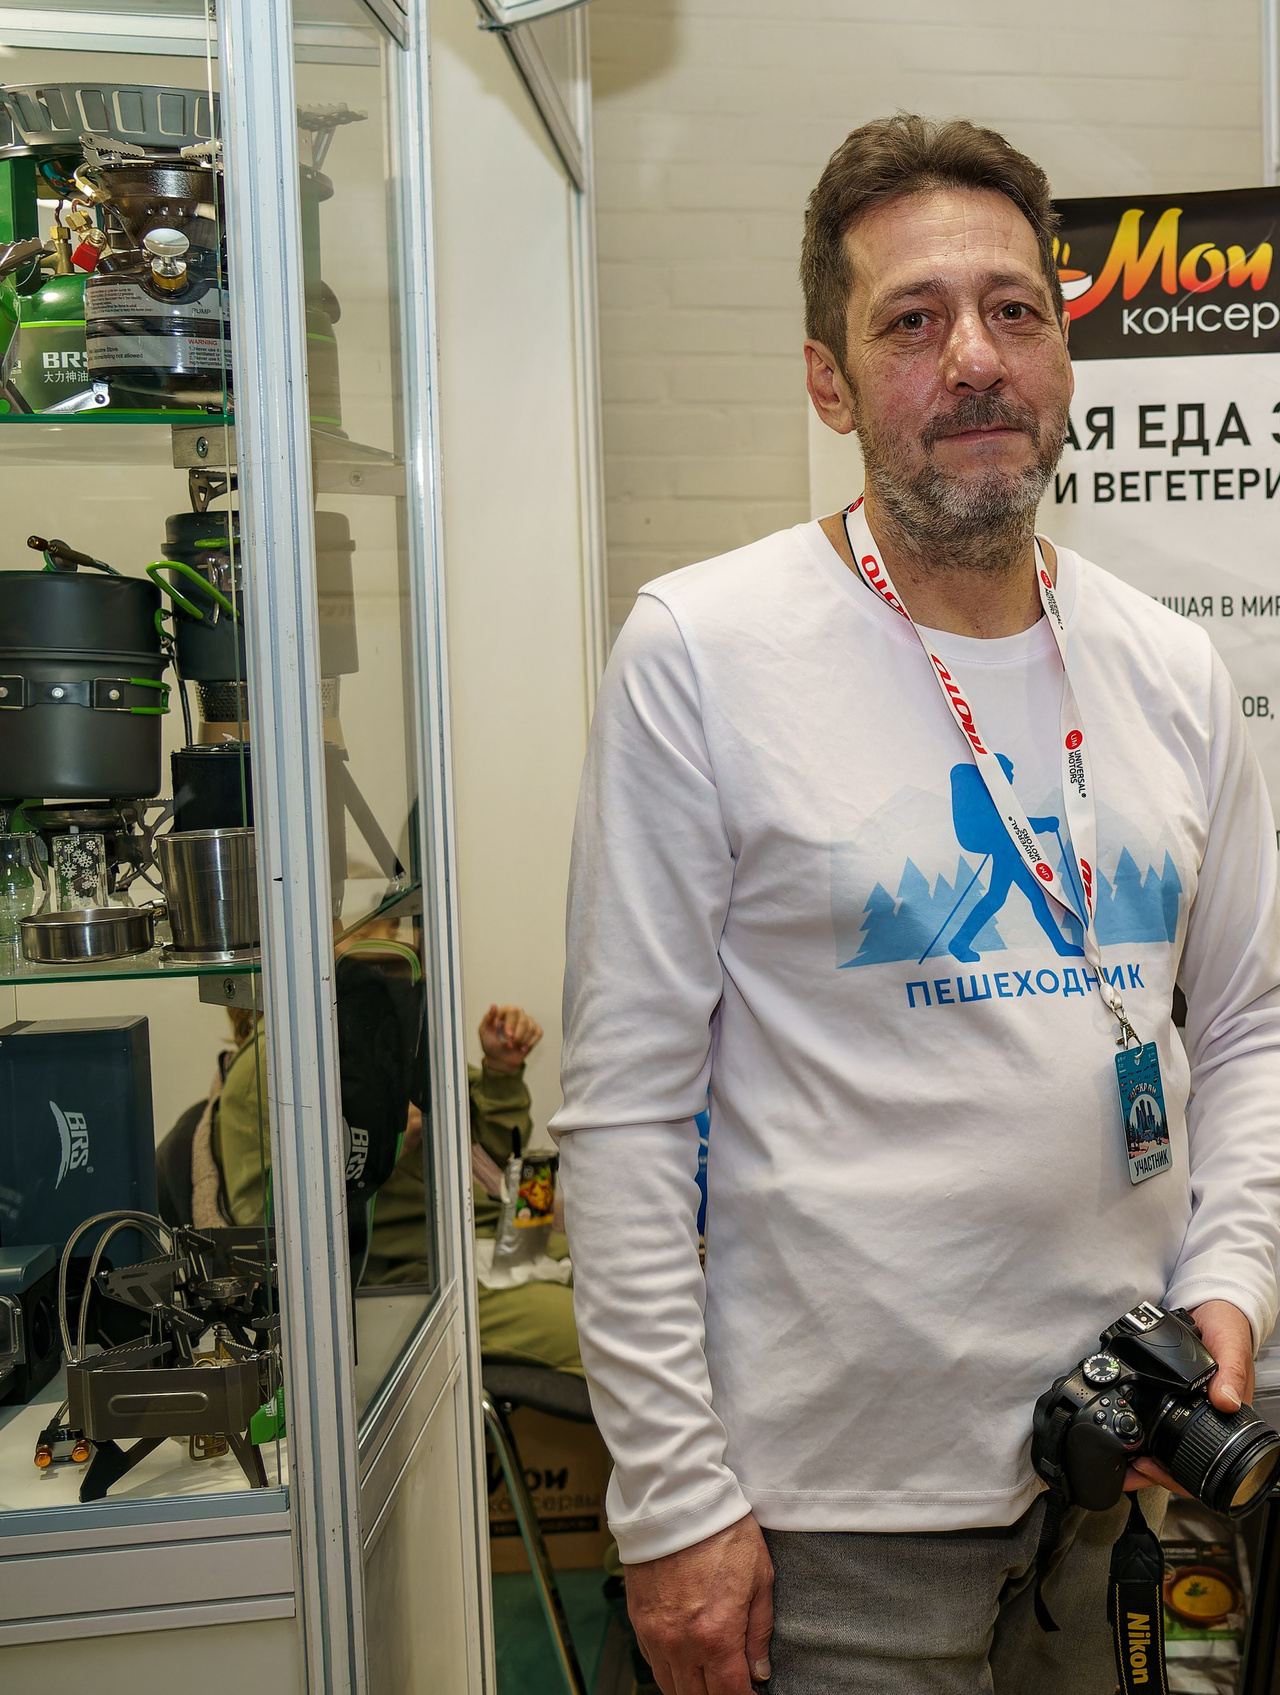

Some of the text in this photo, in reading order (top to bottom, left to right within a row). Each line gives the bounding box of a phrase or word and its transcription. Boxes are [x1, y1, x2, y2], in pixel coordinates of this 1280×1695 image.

[1066, 208, 1273, 320] Мои
[1139, 402, 1252, 456] ЕДА
[1055, 472, 1077, 504] И
[1221, 596, 1234, 617] В
[1067, 751, 1078, 784] MOTORS
[1022, 828, 1042, 861] MOTORS
[905, 963, 1145, 1009] ПЕШЕХОДНИК
[63, 1111, 89, 1170] BRS
[345, 1127, 369, 1180] BRS
[1133, 1149, 1170, 1177] УЧАСТНИК
[1127, 1611, 1151, 1685] Nikon
